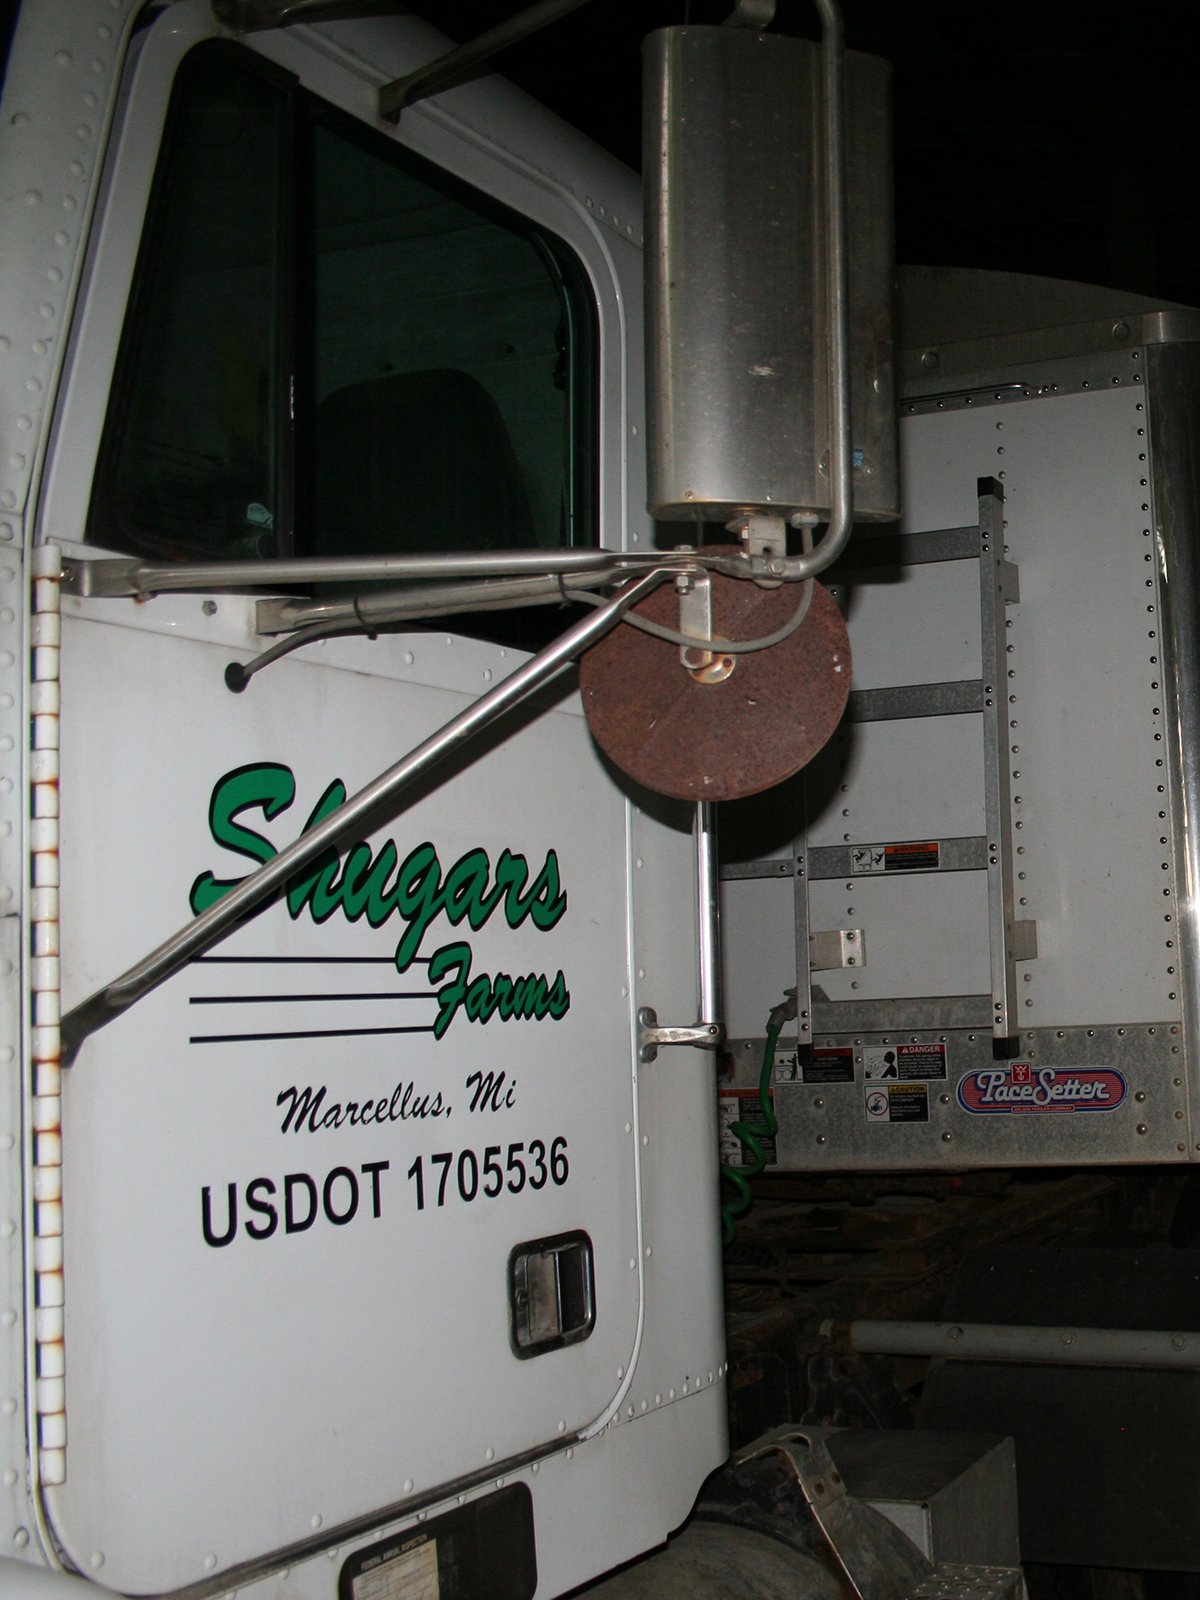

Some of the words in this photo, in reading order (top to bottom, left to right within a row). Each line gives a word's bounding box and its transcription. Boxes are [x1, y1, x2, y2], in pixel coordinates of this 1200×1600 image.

[190, 762, 567, 973] Shugars
[428, 941, 570, 1041] Farms
[908, 1045, 941, 1054] DANGER
[976, 1068, 1110, 1106] PaceSetter
[276, 1080, 454, 1135] Marcellus,
[465, 1070, 517, 1112] Mi
[200, 1160, 391, 1249] USDOT
[406, 1136, 570, 1211] 1705536
